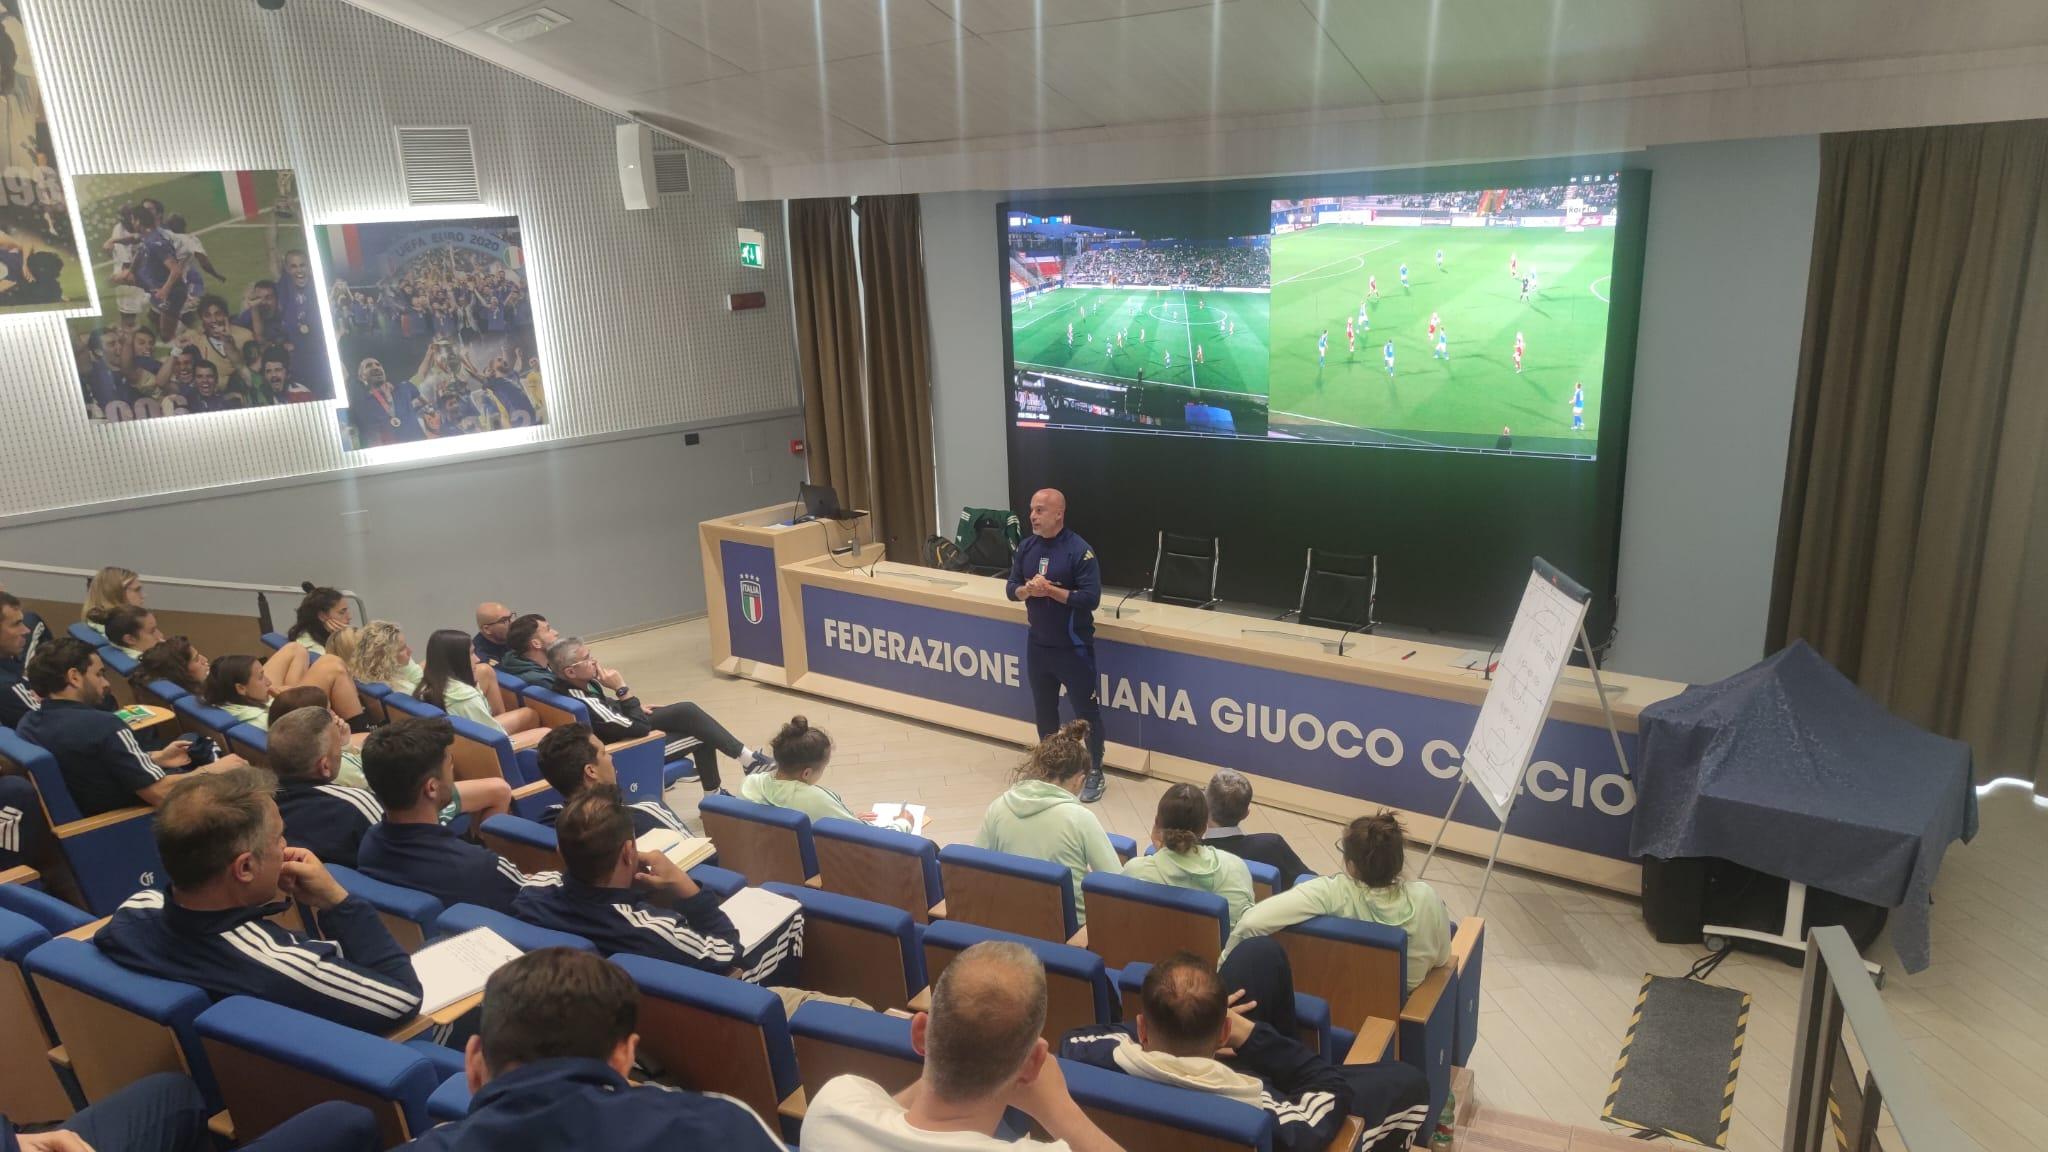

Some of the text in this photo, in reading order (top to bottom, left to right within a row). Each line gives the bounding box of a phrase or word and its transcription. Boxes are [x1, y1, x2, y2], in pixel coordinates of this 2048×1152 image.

[395, 230, 501, 257] UEFA EURO 2020
[742, 583, 760, 595] ITALIA
[824, 618, 1637, 816] FEDERAZIONE IANA GIUOCO CCIO
